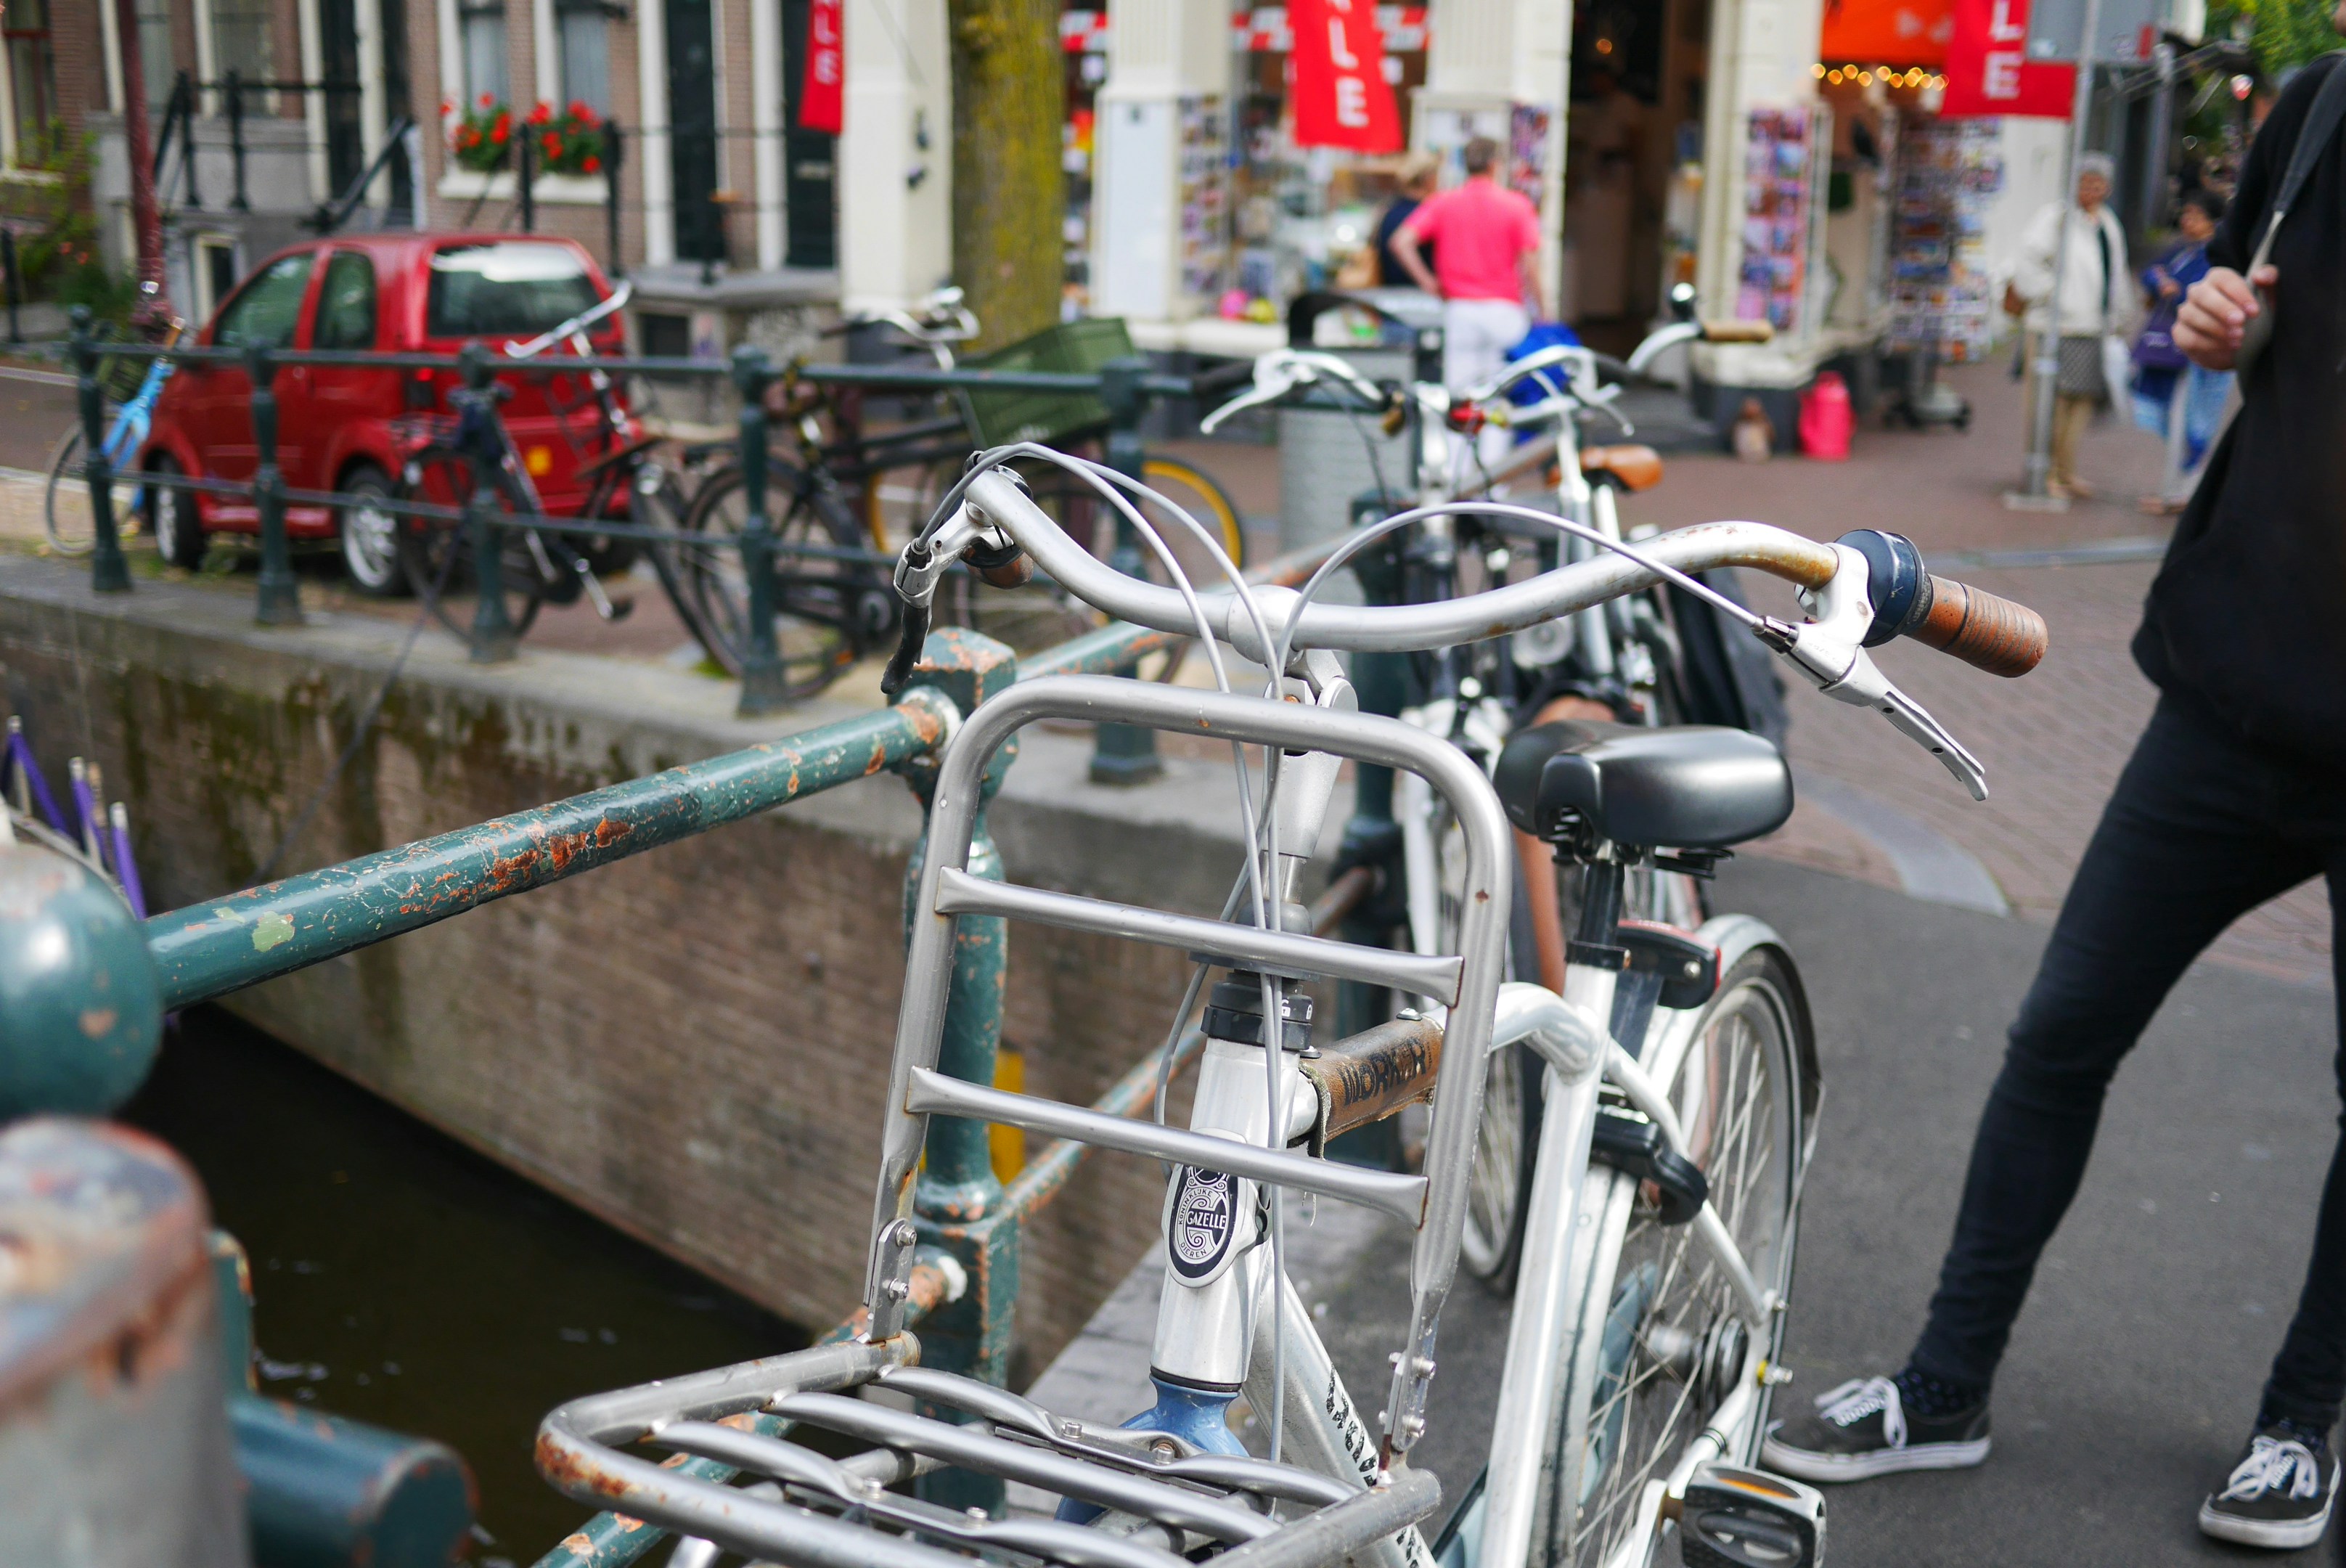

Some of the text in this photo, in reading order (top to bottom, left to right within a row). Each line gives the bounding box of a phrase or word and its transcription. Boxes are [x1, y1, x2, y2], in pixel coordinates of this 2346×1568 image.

[812, 0, 838, 86] LE
[1326, 0, 1370, 128] LE
[1186, 1210, 1227, 1230] GAZELLE
[1180, 1242, 1207, 1258] DIEREN
